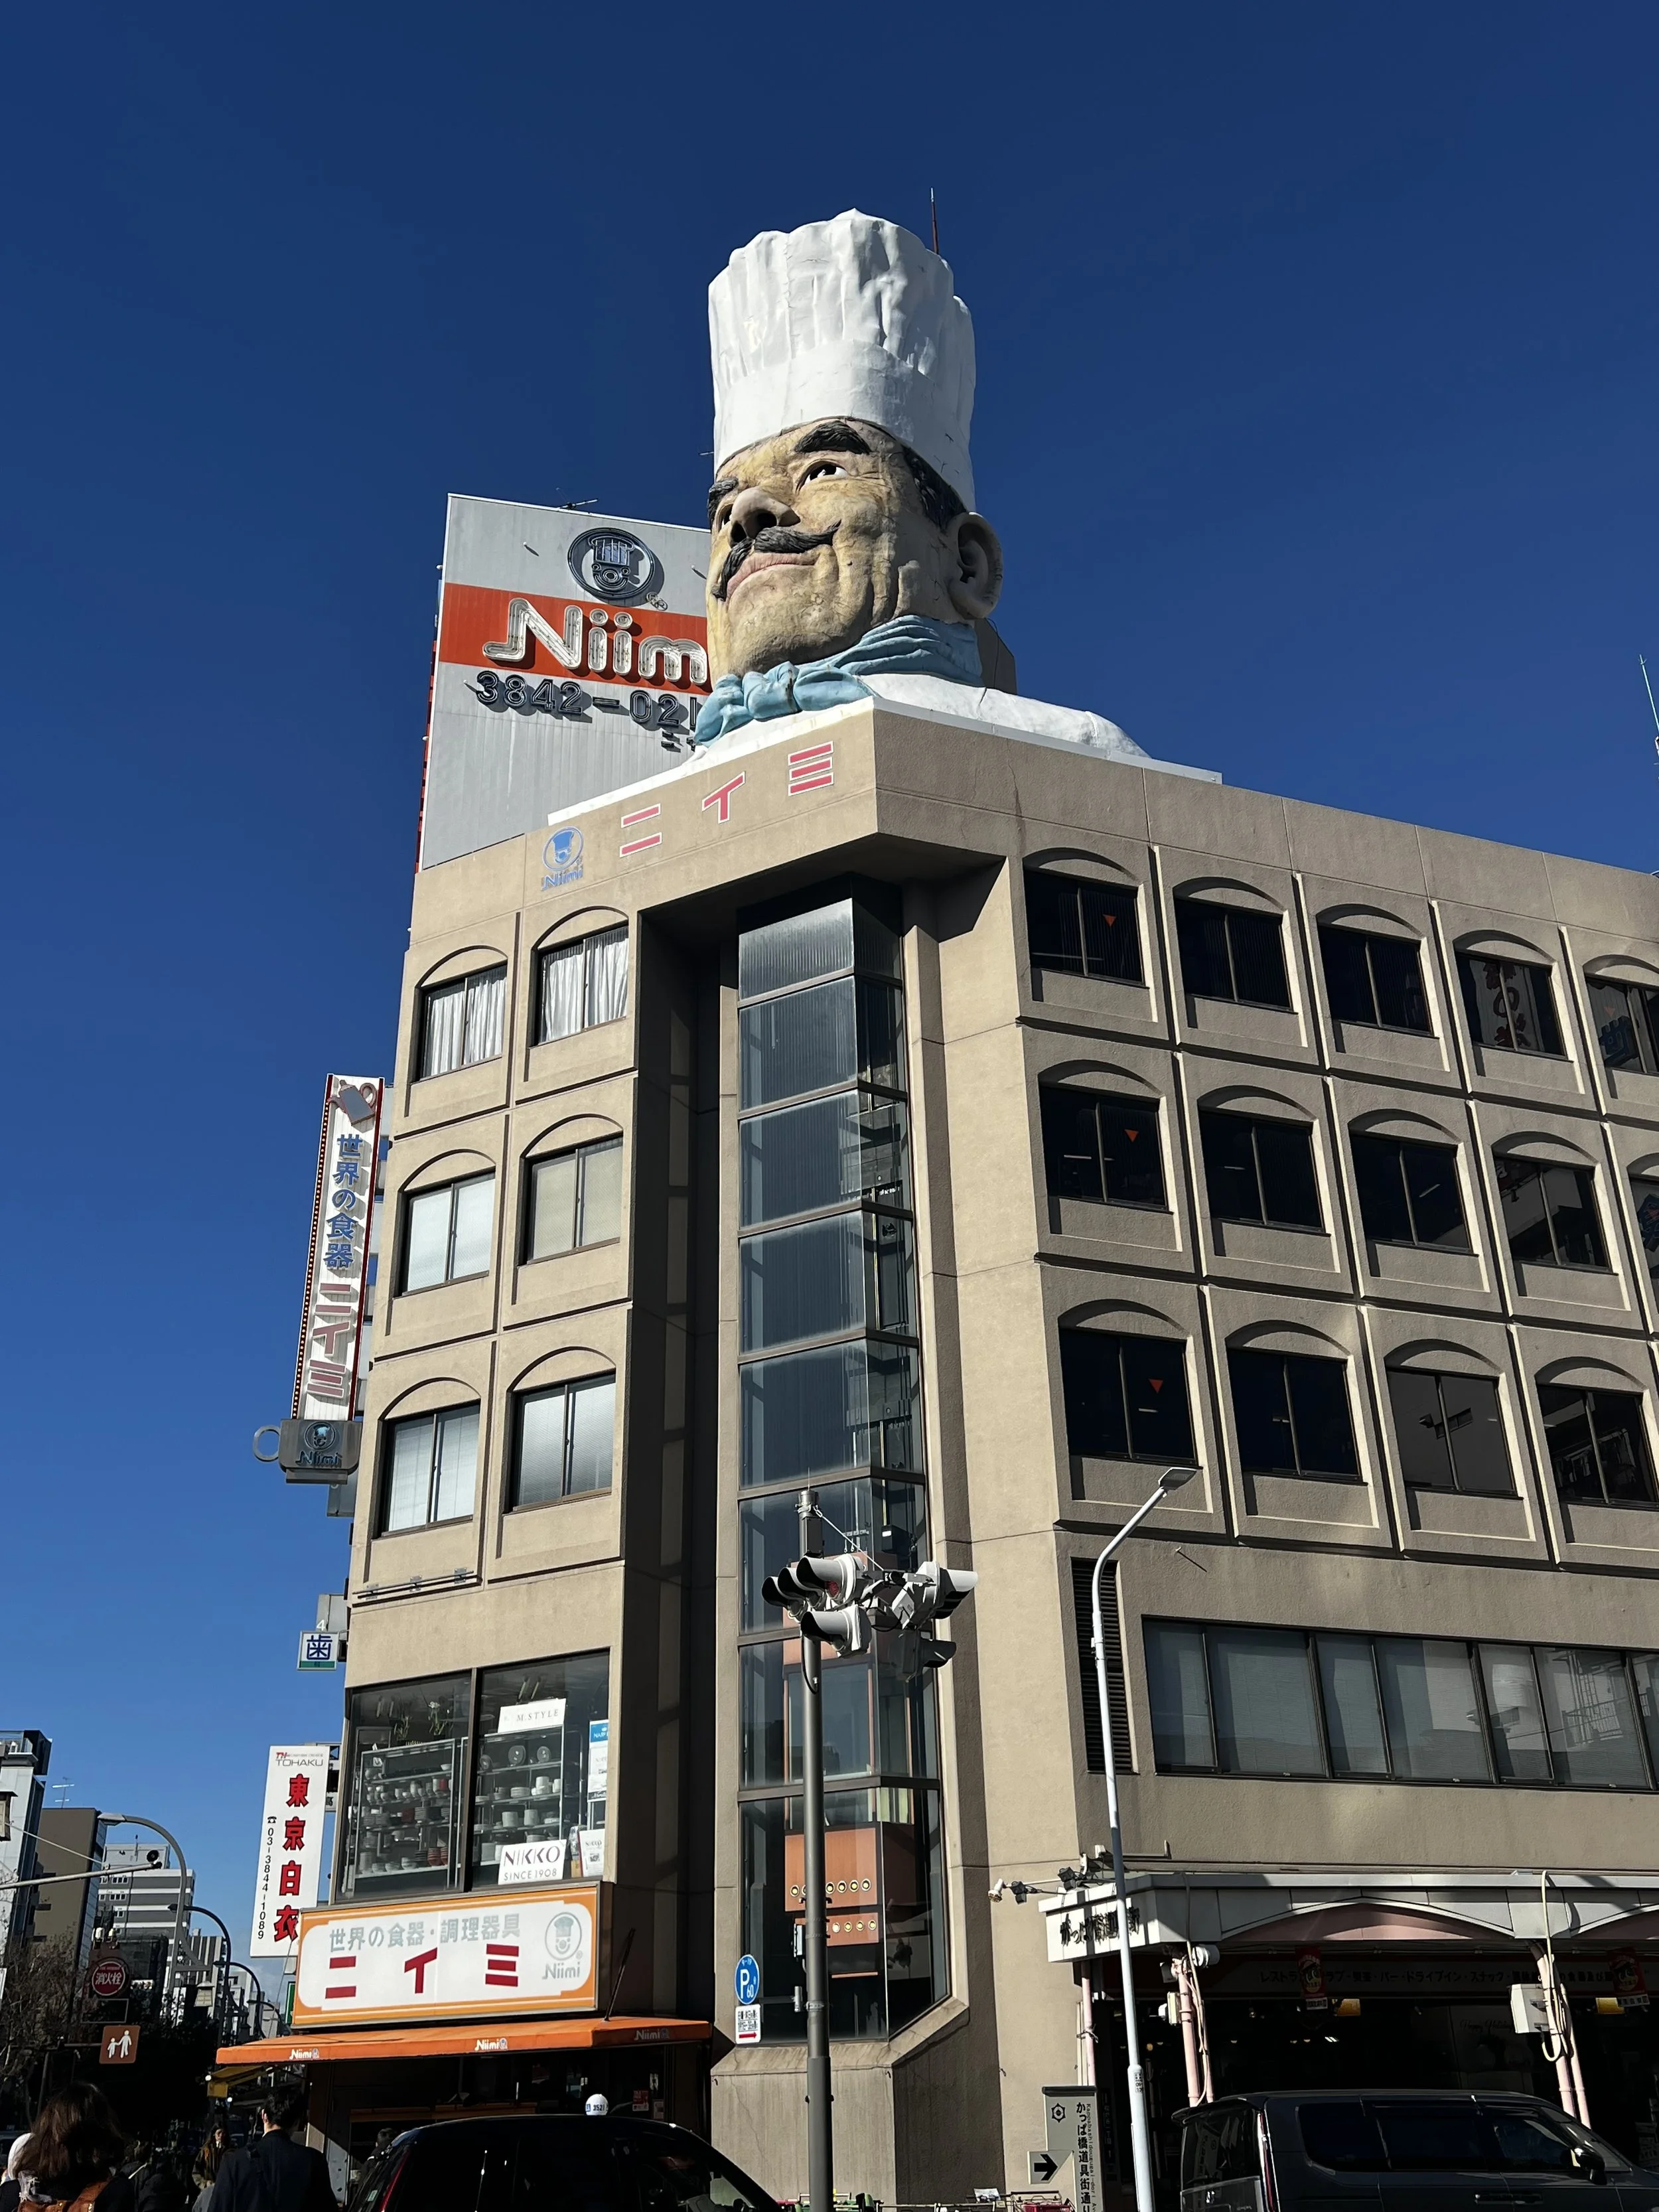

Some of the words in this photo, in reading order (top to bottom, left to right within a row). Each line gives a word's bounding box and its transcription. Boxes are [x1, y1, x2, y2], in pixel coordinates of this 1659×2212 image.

[482, 598, 707, 686] Niim
[619, 741, 834, 857] ニイミ
[541, 862, 584, 891] Niimi
[323, 1133, 363, 1270] 世界の食器
[307, 1282, 352, 1398] ニイミ
[307, 1634, 332, 1660] 歯
[516, 1709, 559, 1722] M.STYLE
[275, 1759, 324, 1767] TOHAKU
[274, 1773, 310, 1942] 東京白衣
[504, 1846, 561, 1868] NIKKO
[257, 1827, 274, 1940] 03-3844-1089
[504, 1870, 532, 1881] SINCE
[534, 1868, 558, 1879] 1908
[330, 1913, 520, 1952] 世界の食器・調理器具
[95, 1971, 122, 1986] 消火栓
[325, 1944, 519, 1999] ニイミ
[542, 1962, 581, 1980] Niimi
[740, 1968, 750, 2000] P
[474, 2039, 499, 2051] Niimi
[634, 2028, 661, 2042] Niimi
[289, 2048, 312, 2060] Niimi
[1076, 2102, 1092, 2212] かっぱ橋道具街通り
